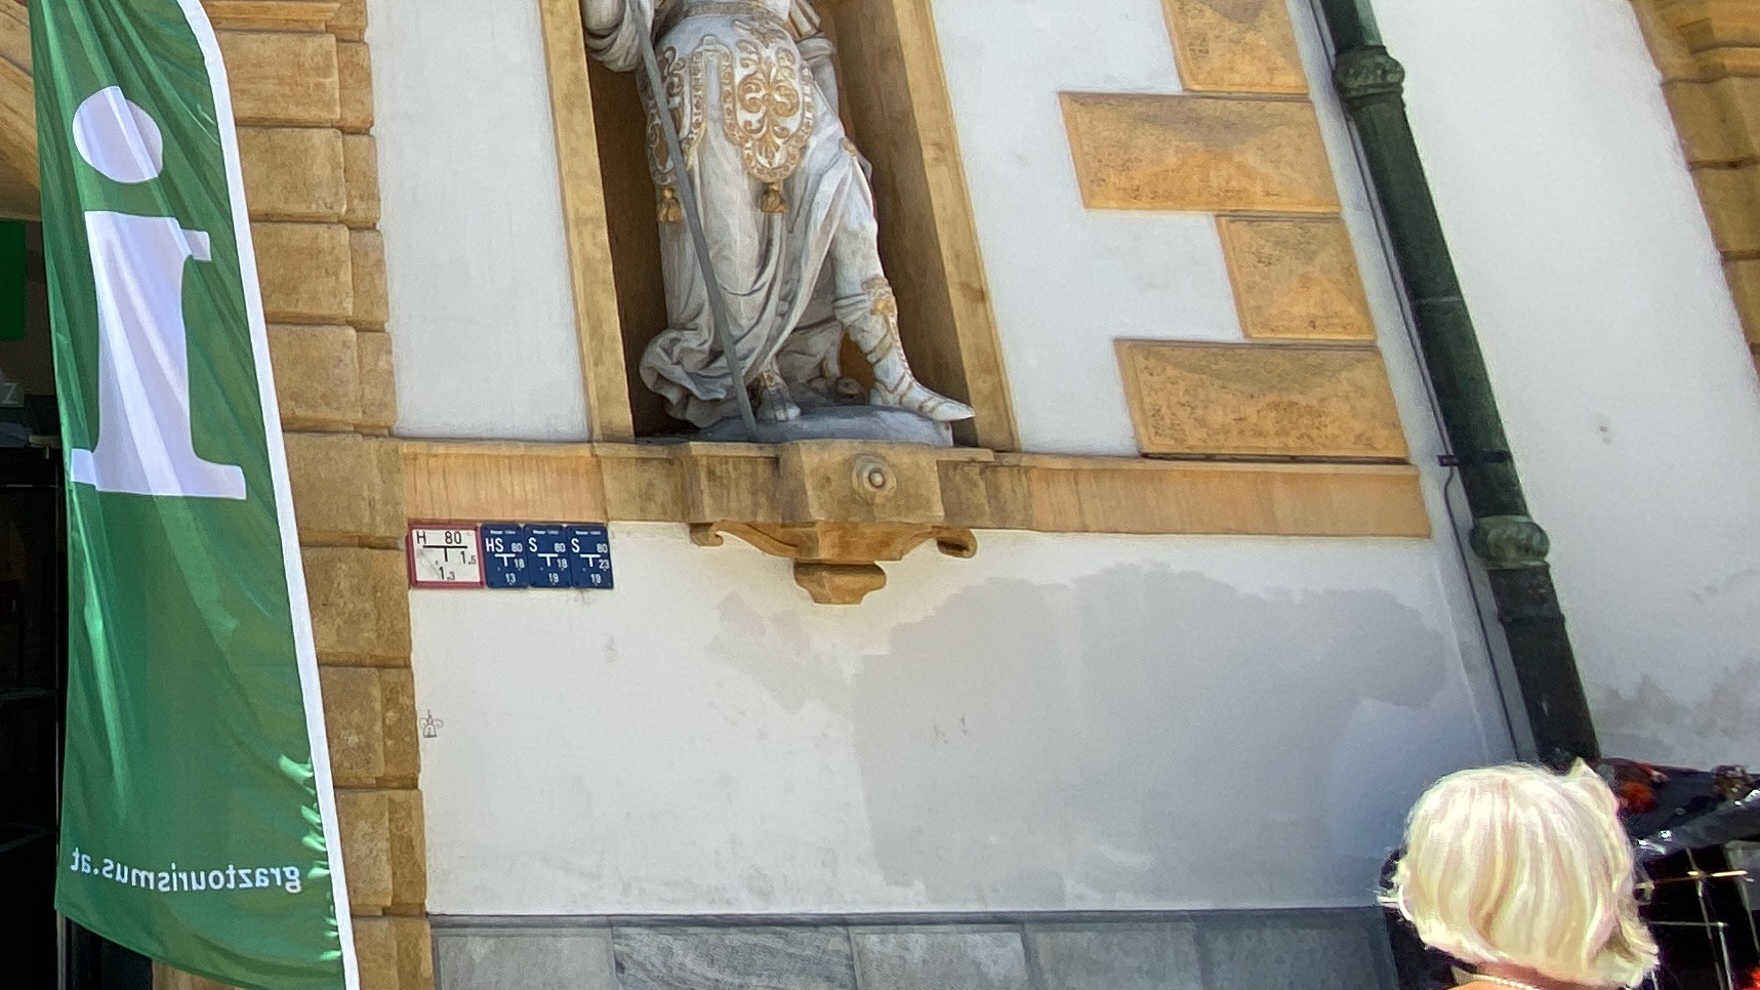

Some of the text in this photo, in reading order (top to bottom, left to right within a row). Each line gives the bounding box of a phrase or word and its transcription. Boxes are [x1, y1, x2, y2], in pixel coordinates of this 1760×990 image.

[416, 531, 462, 545] H 80
[485, 538, 505, 552] HS
[528, 537, 538, 552] S
[571, 538, 580, 553] S
